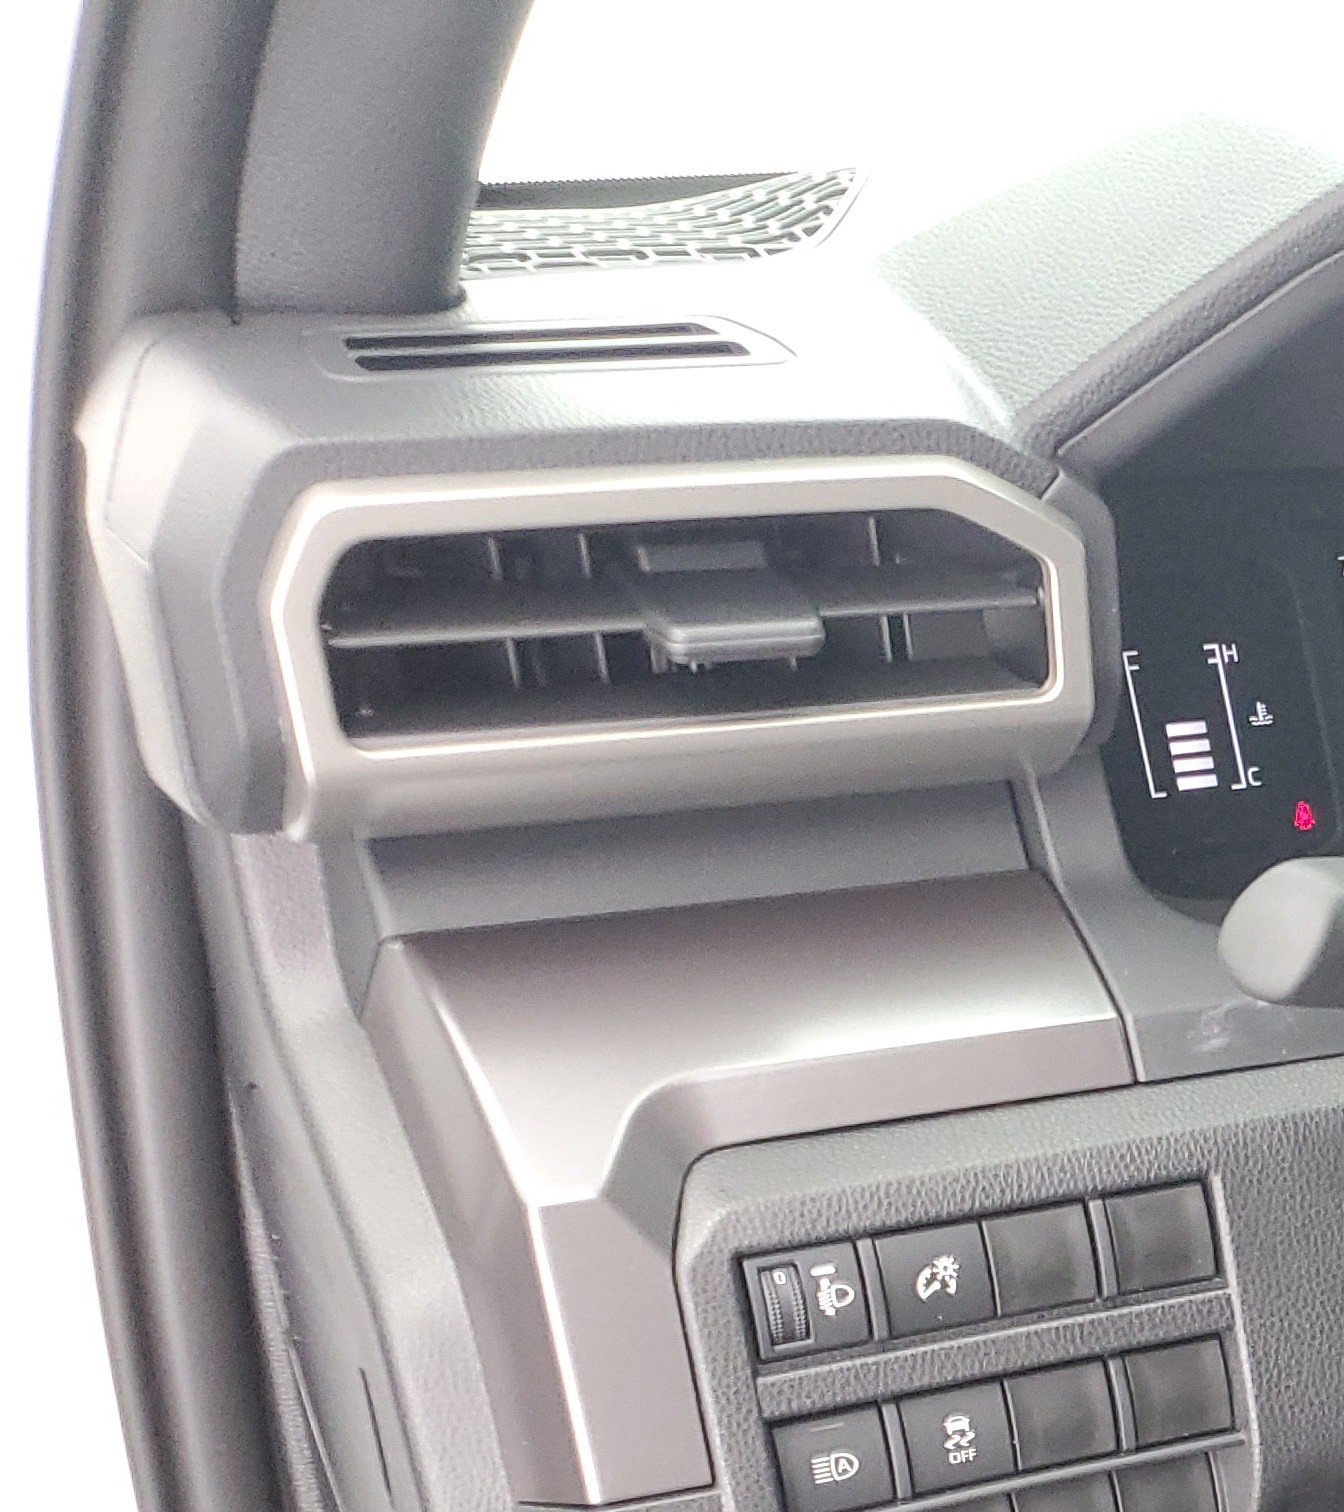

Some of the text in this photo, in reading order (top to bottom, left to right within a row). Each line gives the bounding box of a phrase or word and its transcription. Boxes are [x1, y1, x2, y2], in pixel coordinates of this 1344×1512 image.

[1221, 643, 1239, 664] H
[1247, 766, 1262, 787] C
[948, 1448, 977, 1465] OFF
